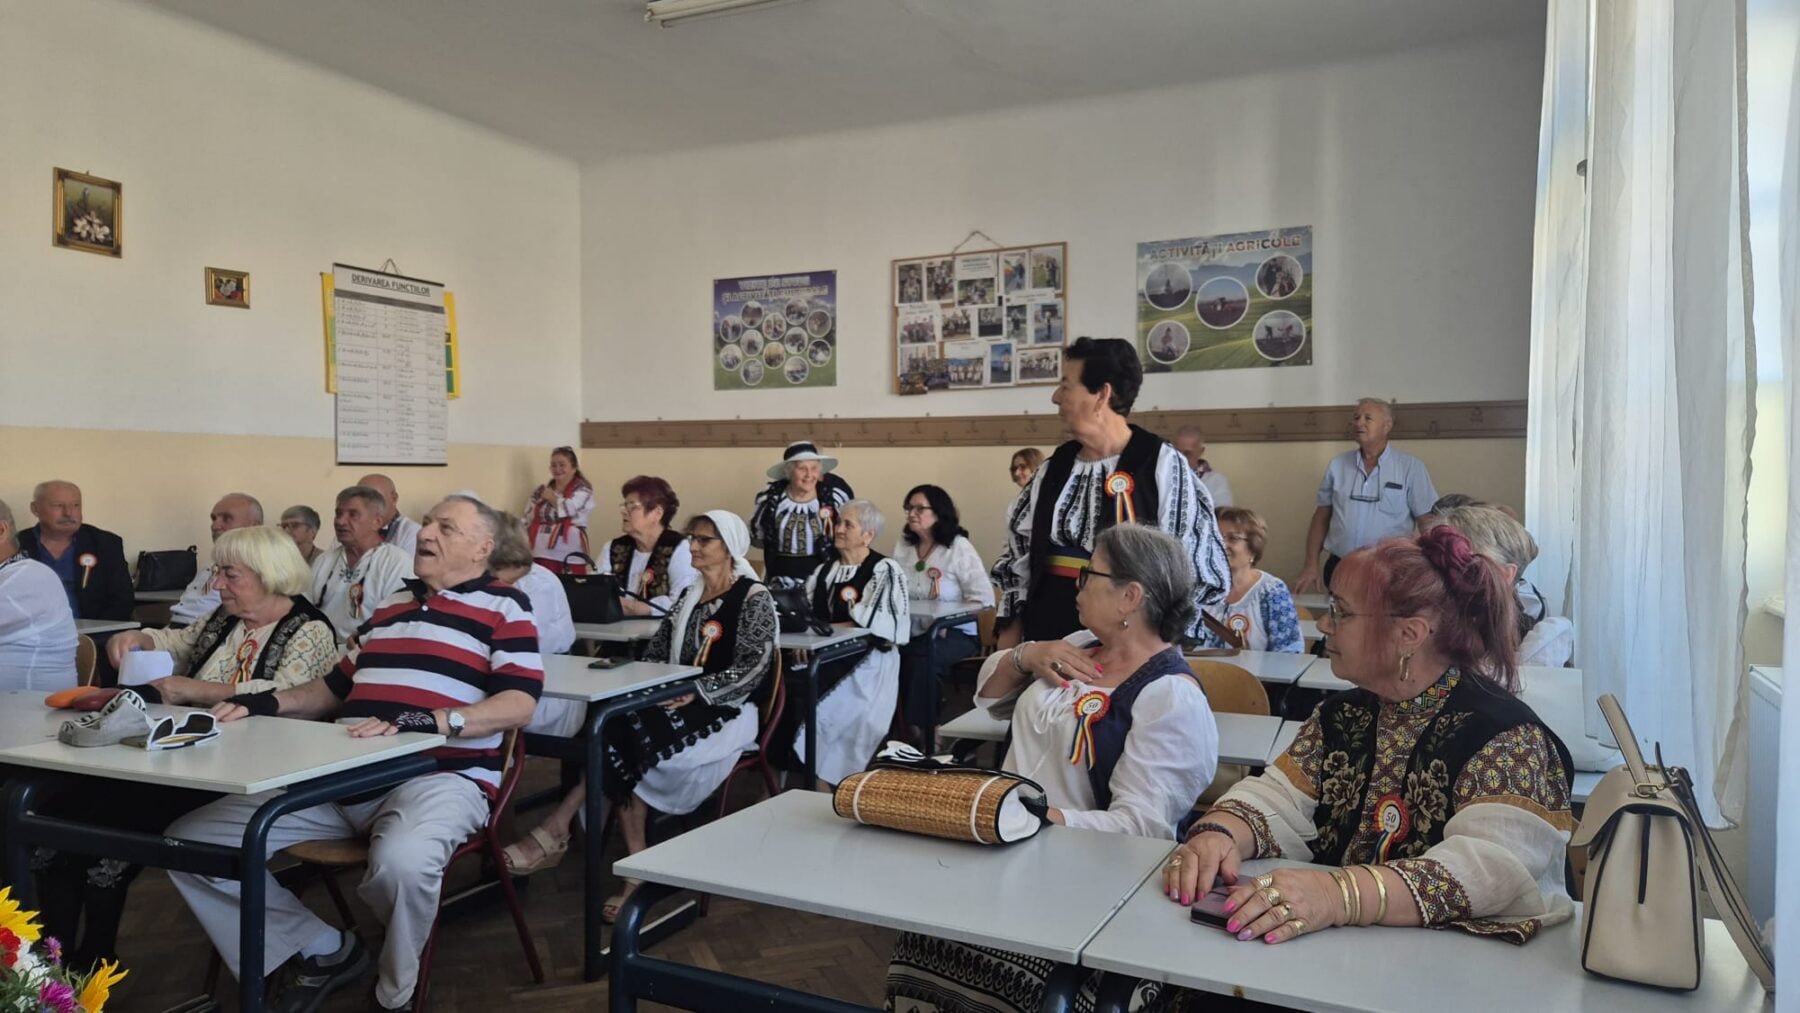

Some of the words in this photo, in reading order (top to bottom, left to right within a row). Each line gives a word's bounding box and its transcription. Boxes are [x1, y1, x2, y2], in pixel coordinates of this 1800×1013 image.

[1226, 236, 1301, 253] AGRICOLE
[352, 274, 389, 288] DERIVAREA
[1386, 812, 1396, 823] 50
